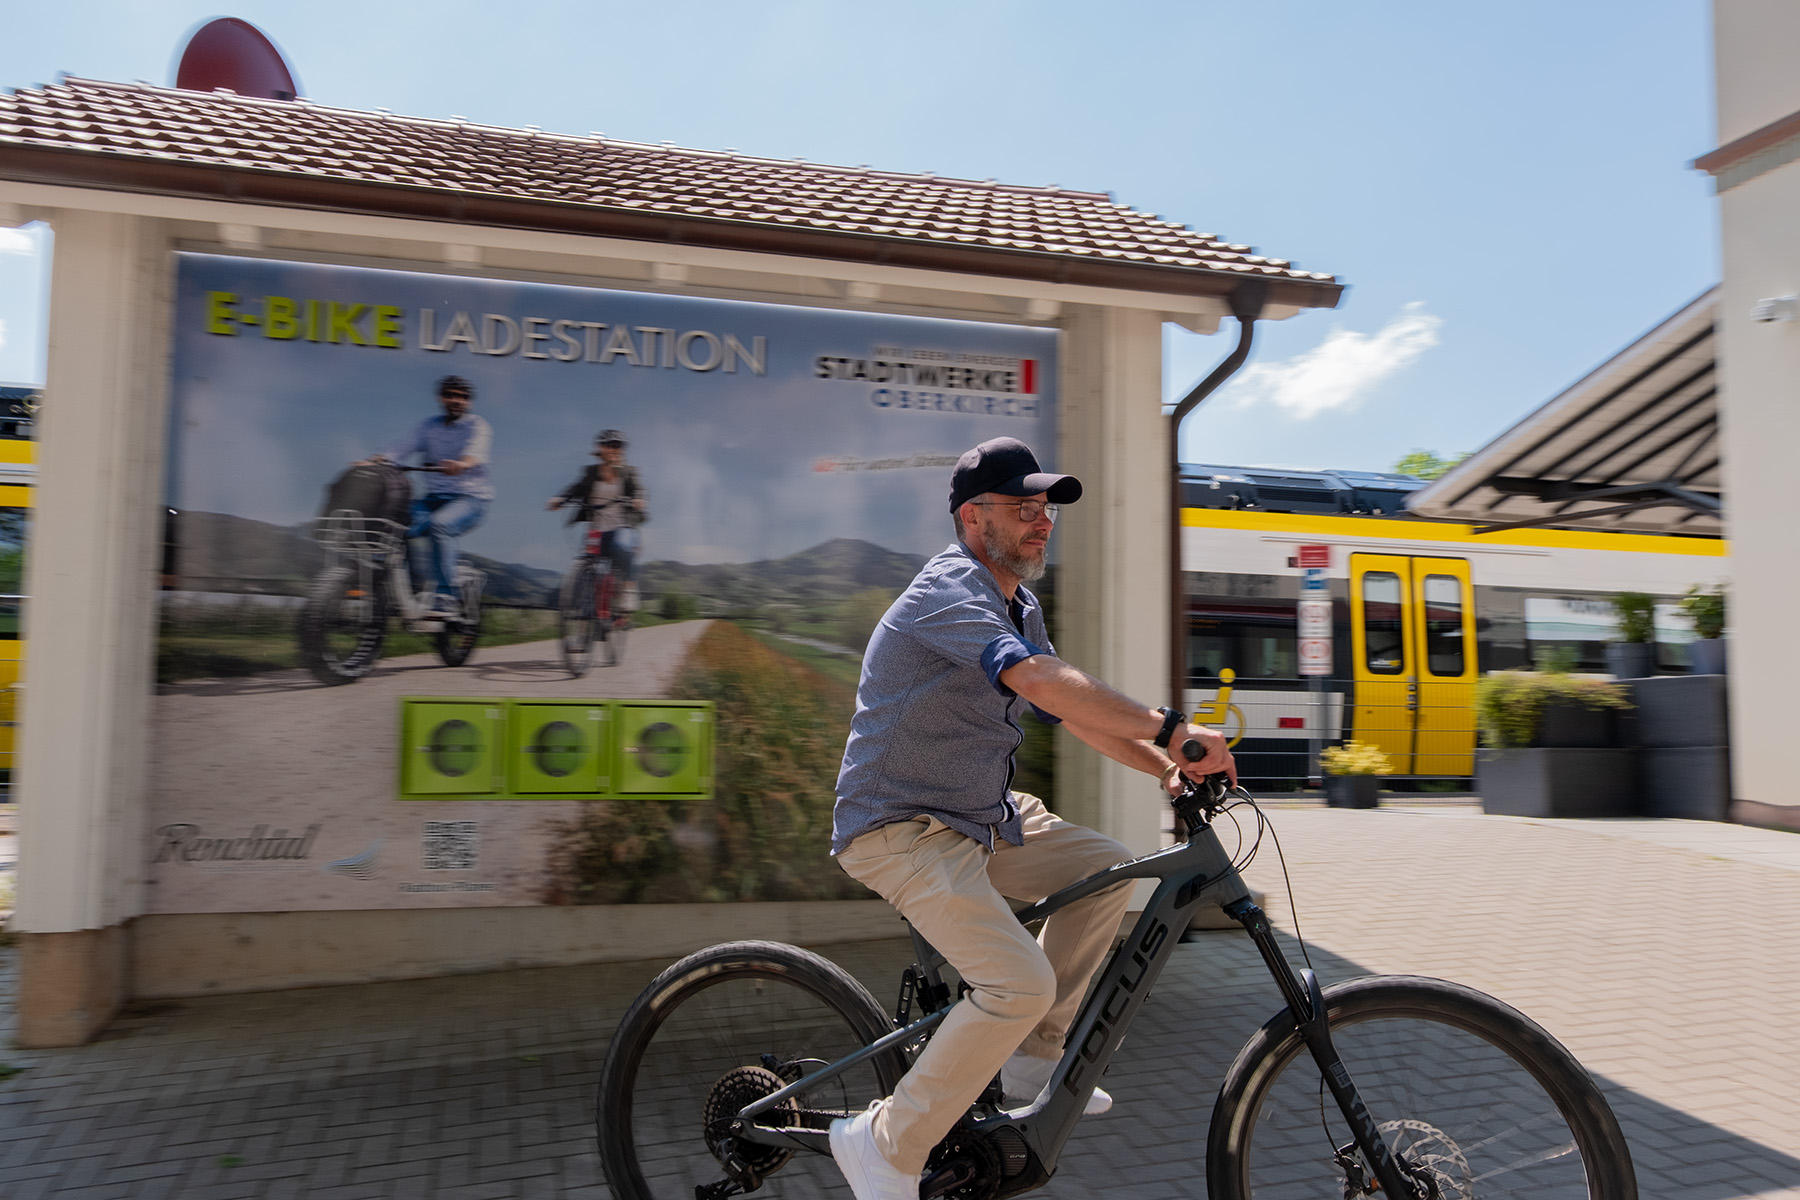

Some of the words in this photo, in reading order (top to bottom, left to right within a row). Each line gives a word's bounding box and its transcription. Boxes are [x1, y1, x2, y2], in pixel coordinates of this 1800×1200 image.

[206, 290, 402, 348] E-BIKE
[418, 307, 768, 375] LADESTATION
[814, 355, 1019, 393] STADTWERKE
[871, 387, 1039, 418] OBERKIRCH
[1063, 916, 1169, 1098] FOCUS
